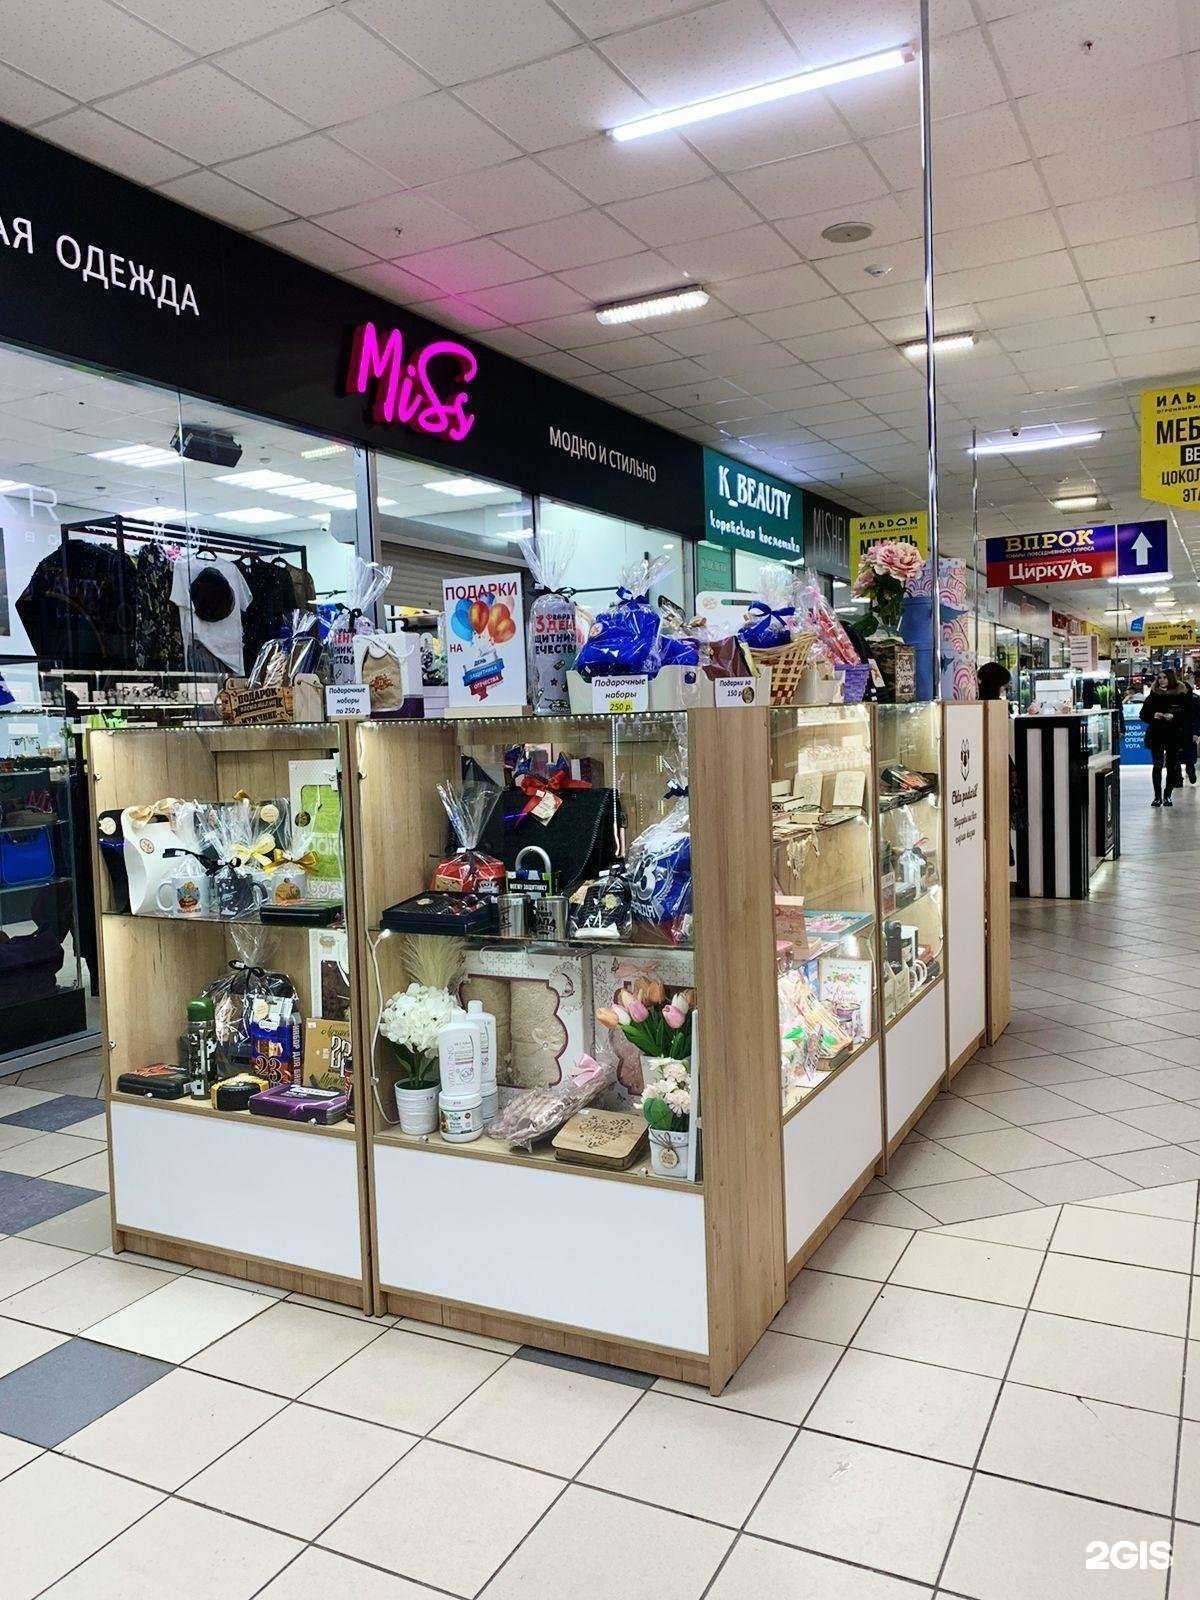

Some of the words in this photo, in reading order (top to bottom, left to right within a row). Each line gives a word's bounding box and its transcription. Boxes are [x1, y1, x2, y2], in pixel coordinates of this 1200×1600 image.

[56, 234, 200, 316] ОДЕЖДА
[549, 426, 597, 460] МОДНО
[599, 445, 607, 465] И
[609, 449, 657, 483] СТИЛЬНО
[1005, 529, 1095, 552] ВПРОК
[445, 582, 518, 600] ПОДАРКИ
[450, 644, 464, 653] НА
[594, 678, 647, 688] Подарочные
[237, 687, 278, 704] ПОДАРОК
[605, 692, 637, 700] наборы
[609, 702, 624, 712] 250
